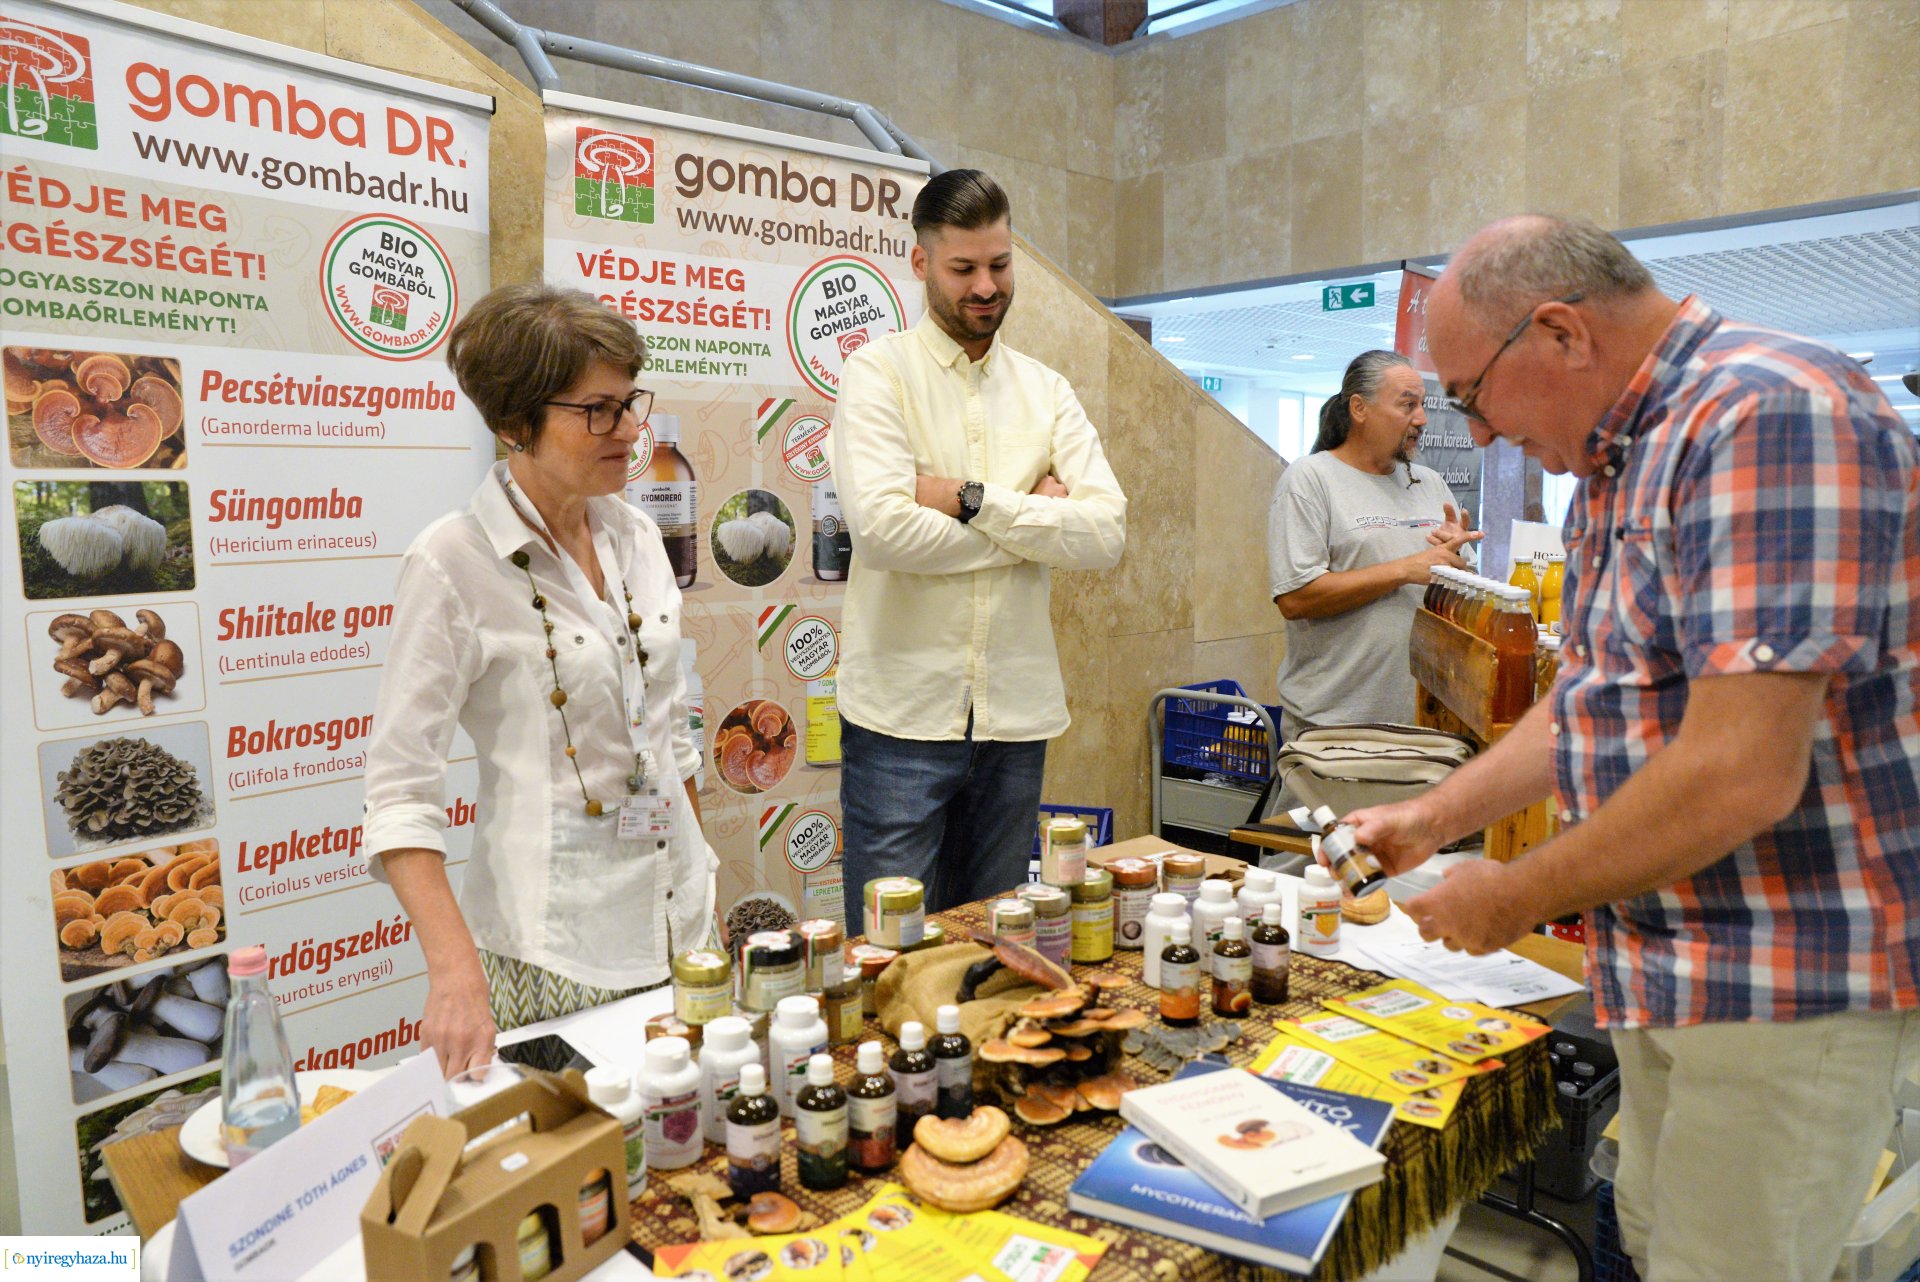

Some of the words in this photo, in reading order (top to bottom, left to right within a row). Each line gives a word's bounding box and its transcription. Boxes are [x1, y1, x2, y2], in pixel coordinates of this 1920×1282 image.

[126, 62, 366, 148] gomba
[387, 107, 467, 168] DR.
[132, 132, 468, 213] www.gombadr.hu
[675, 153, 835, 208] gomba
[851, 173, 908, 220] DR.
[0, 165, 127, 218] ÉDJE
[142, 194, 227, 232] MEG
[0, 219, 266, 281] GÉSZSÉGÉT!
[380, 231, 418, 258] BIO
[676, 207, 906, 258] www.gombadr.hu
[349, 262, 436, 299] GOMBÁBÓL
[362, 248, 424, 279] MAGYAR
[576, 248, 676, 285] VÉDJE
[686, 264, 745, 292] MEG
[0, 268, 153, 300] OGYASSZON
[161, 286, 269, 312] NAPONTA
[822, 274, 856, 299] BIO
[1407, 288, 1422, 313] A
[0, 298, 236, 333] OMBAŐRLEMÉNYT!
[335, 285, 441, 347] WWW.GOMBADR.HU
[597, 290, 771, 331] ÉSZSÉGÉT!
[810, 305, 885, 340] GOMBÁBÓL
[815, 294, 869, 321] MAGYAR
[641, 335, 690, 352] SZON
[695, 339, 771, 357] NAPONTA
[201, 369, 456, 417] Pecsétviaszgomba
[201, 416, 311, 436] (Ganorderma
[317, 421, 386, 440] lucidum)
[1444, 430, 1473, 449] köretek
[628, 438, 648, 474] OMBADR.HU
[1446, 466, 1470, 484] babok
[208, 487, 362, 530] Süngomba
[209, 535, 292, 557] (Hericium
[297, 531, 377, 552] erinaceus)
[217, 601, 336, 641] Shiitake
[790, 625, 822, 653] 100%
[799, 641, 829, 666] MAGYAR
[219, 650, 305, 675] (Lentinula
[310, 641, 370, 663] edodes)
[229, 766, 289, 792] (Glifola
[293, 751, 367, 778] frondosa)
[791, 819, 823, 848] 100%
[800, 833, 829, 861] MAGYAR
[803, 841, 831, 865] GOMBÁBÓL
[239, 874, 310, 906] (Coriolus
[256, 914, 413, 980] rdögszekér
[273, 979, 334, 1007] eurotus
[338, 958, 393, 988] eryngii)
[228, 1204, 295, 1258] SZONDINÉ
[296, 1181, 328, 1211] TÓTH
[330, 1154, 368, 1188] ÁGNES
